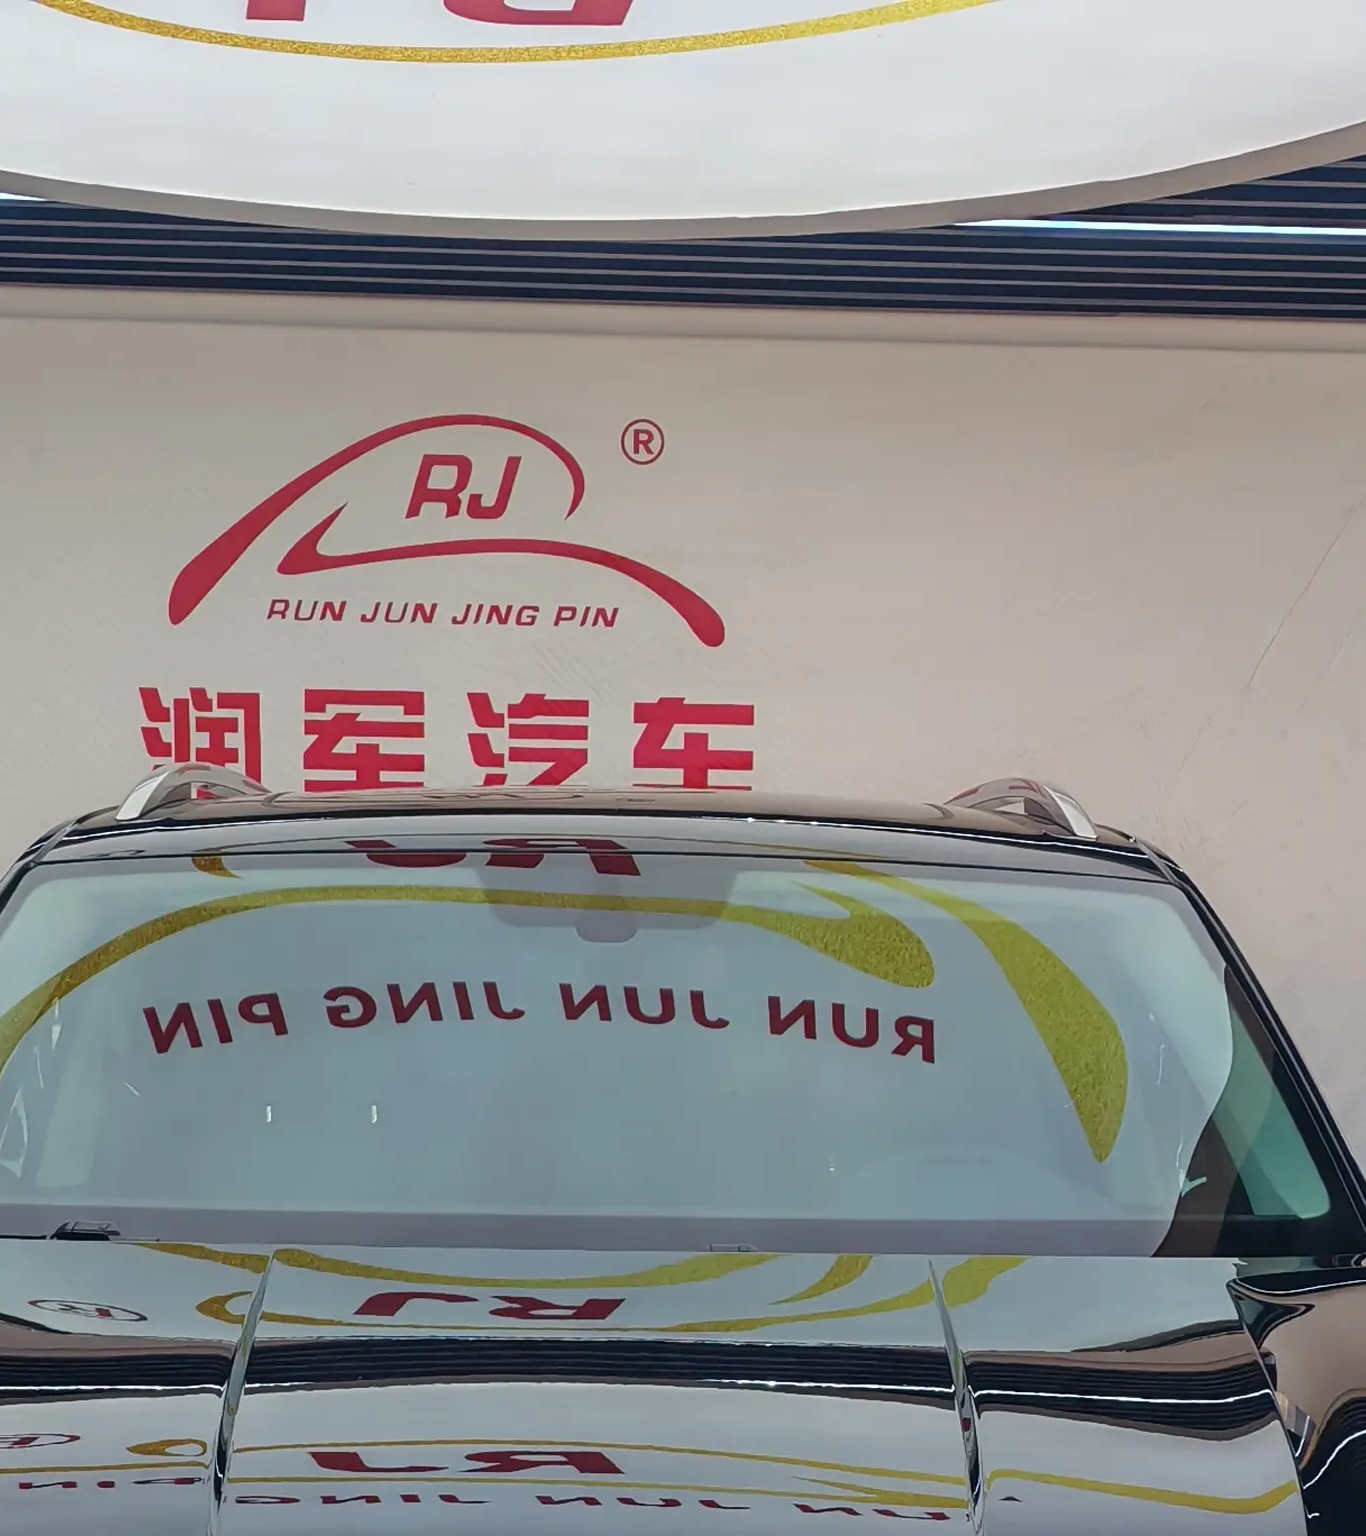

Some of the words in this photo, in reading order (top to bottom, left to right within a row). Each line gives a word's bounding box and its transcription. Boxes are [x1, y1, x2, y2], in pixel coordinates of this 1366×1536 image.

[404, 453, 522, 520] RJ
[266, 597, 346, 623] RUN
[359, 601, 438, 625] JUN
[450, 602, 541, 627] JING
[552, 605, 620, 629] PIN
[137, 686, 756, 796] 润军汽车
